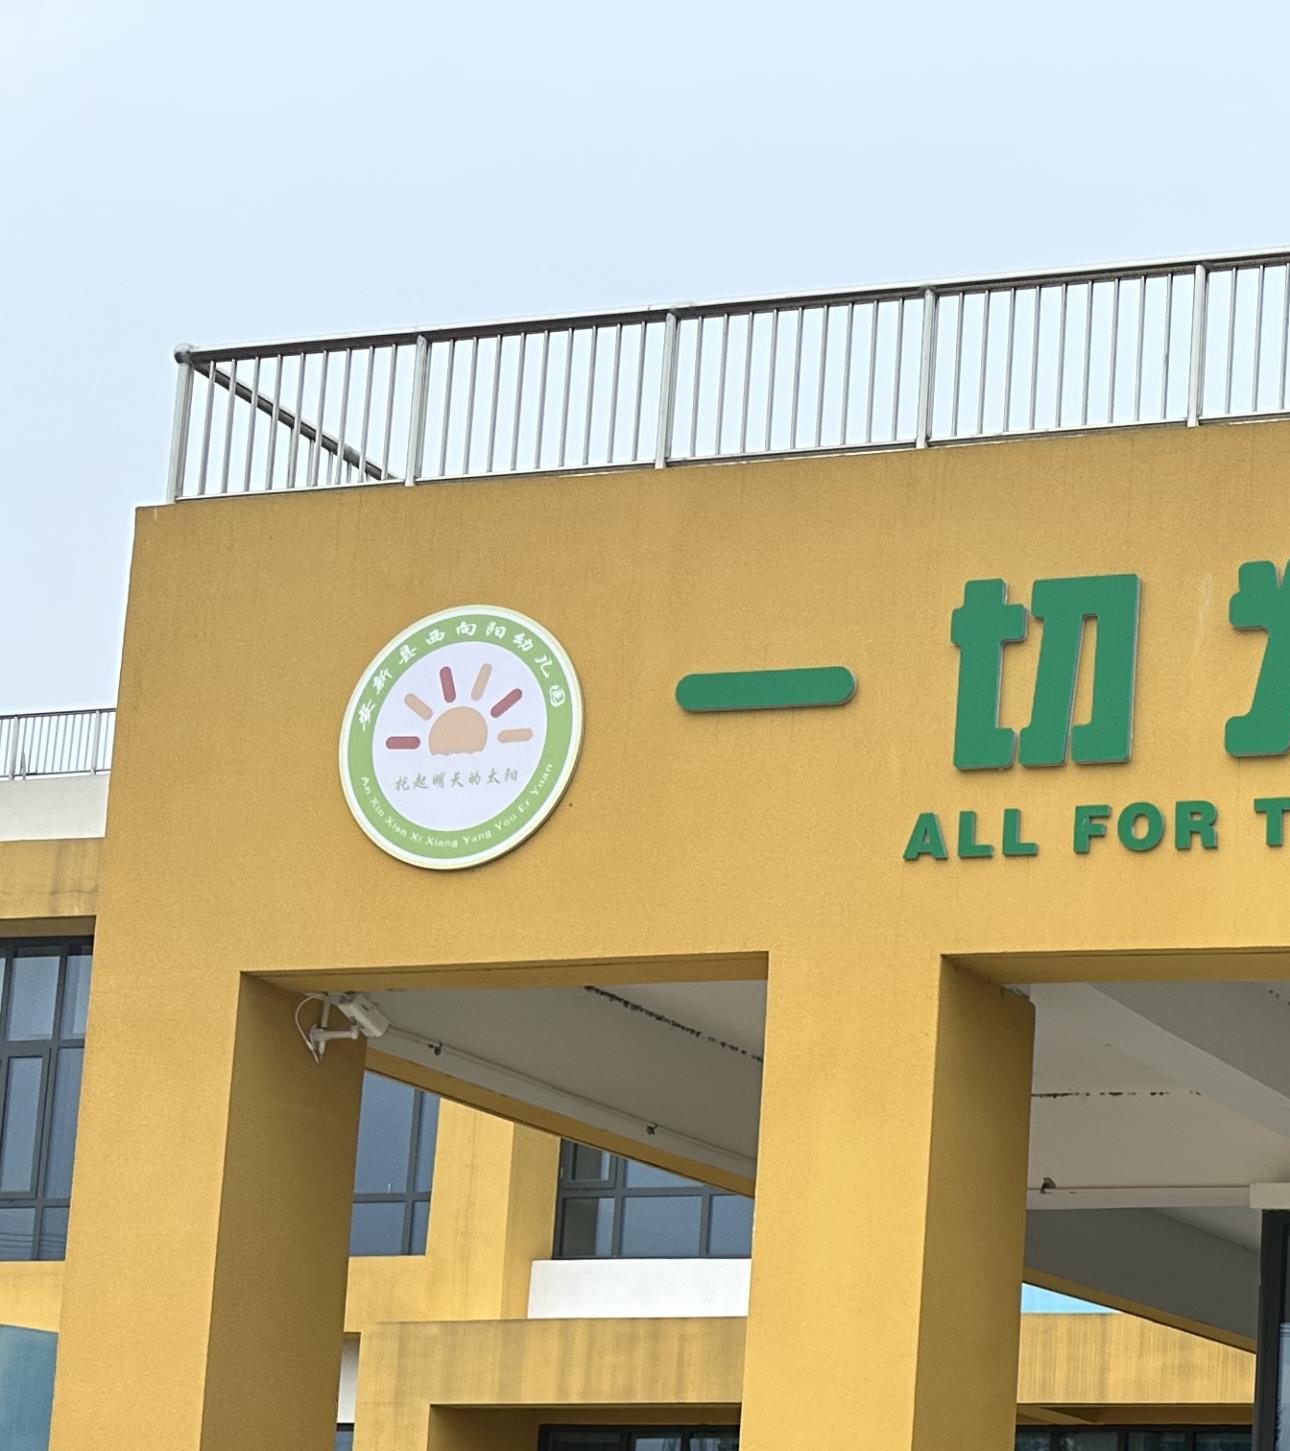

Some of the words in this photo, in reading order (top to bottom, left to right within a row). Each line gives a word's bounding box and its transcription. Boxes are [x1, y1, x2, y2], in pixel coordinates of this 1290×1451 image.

[356, 620, 567, 732] 安新县西向阳幼儿园
[394, 766, 519, 792] 托起明天的太阳
[426, 836, 459, 849] Xiang
[462, 829, 493, 845] Yang
[494, 814, 518, 832] You
[530, 763, 554, 796] Yuan
[904, 806, 1038, 860] ALL
[1074, 799, 1217, 851] FOR
